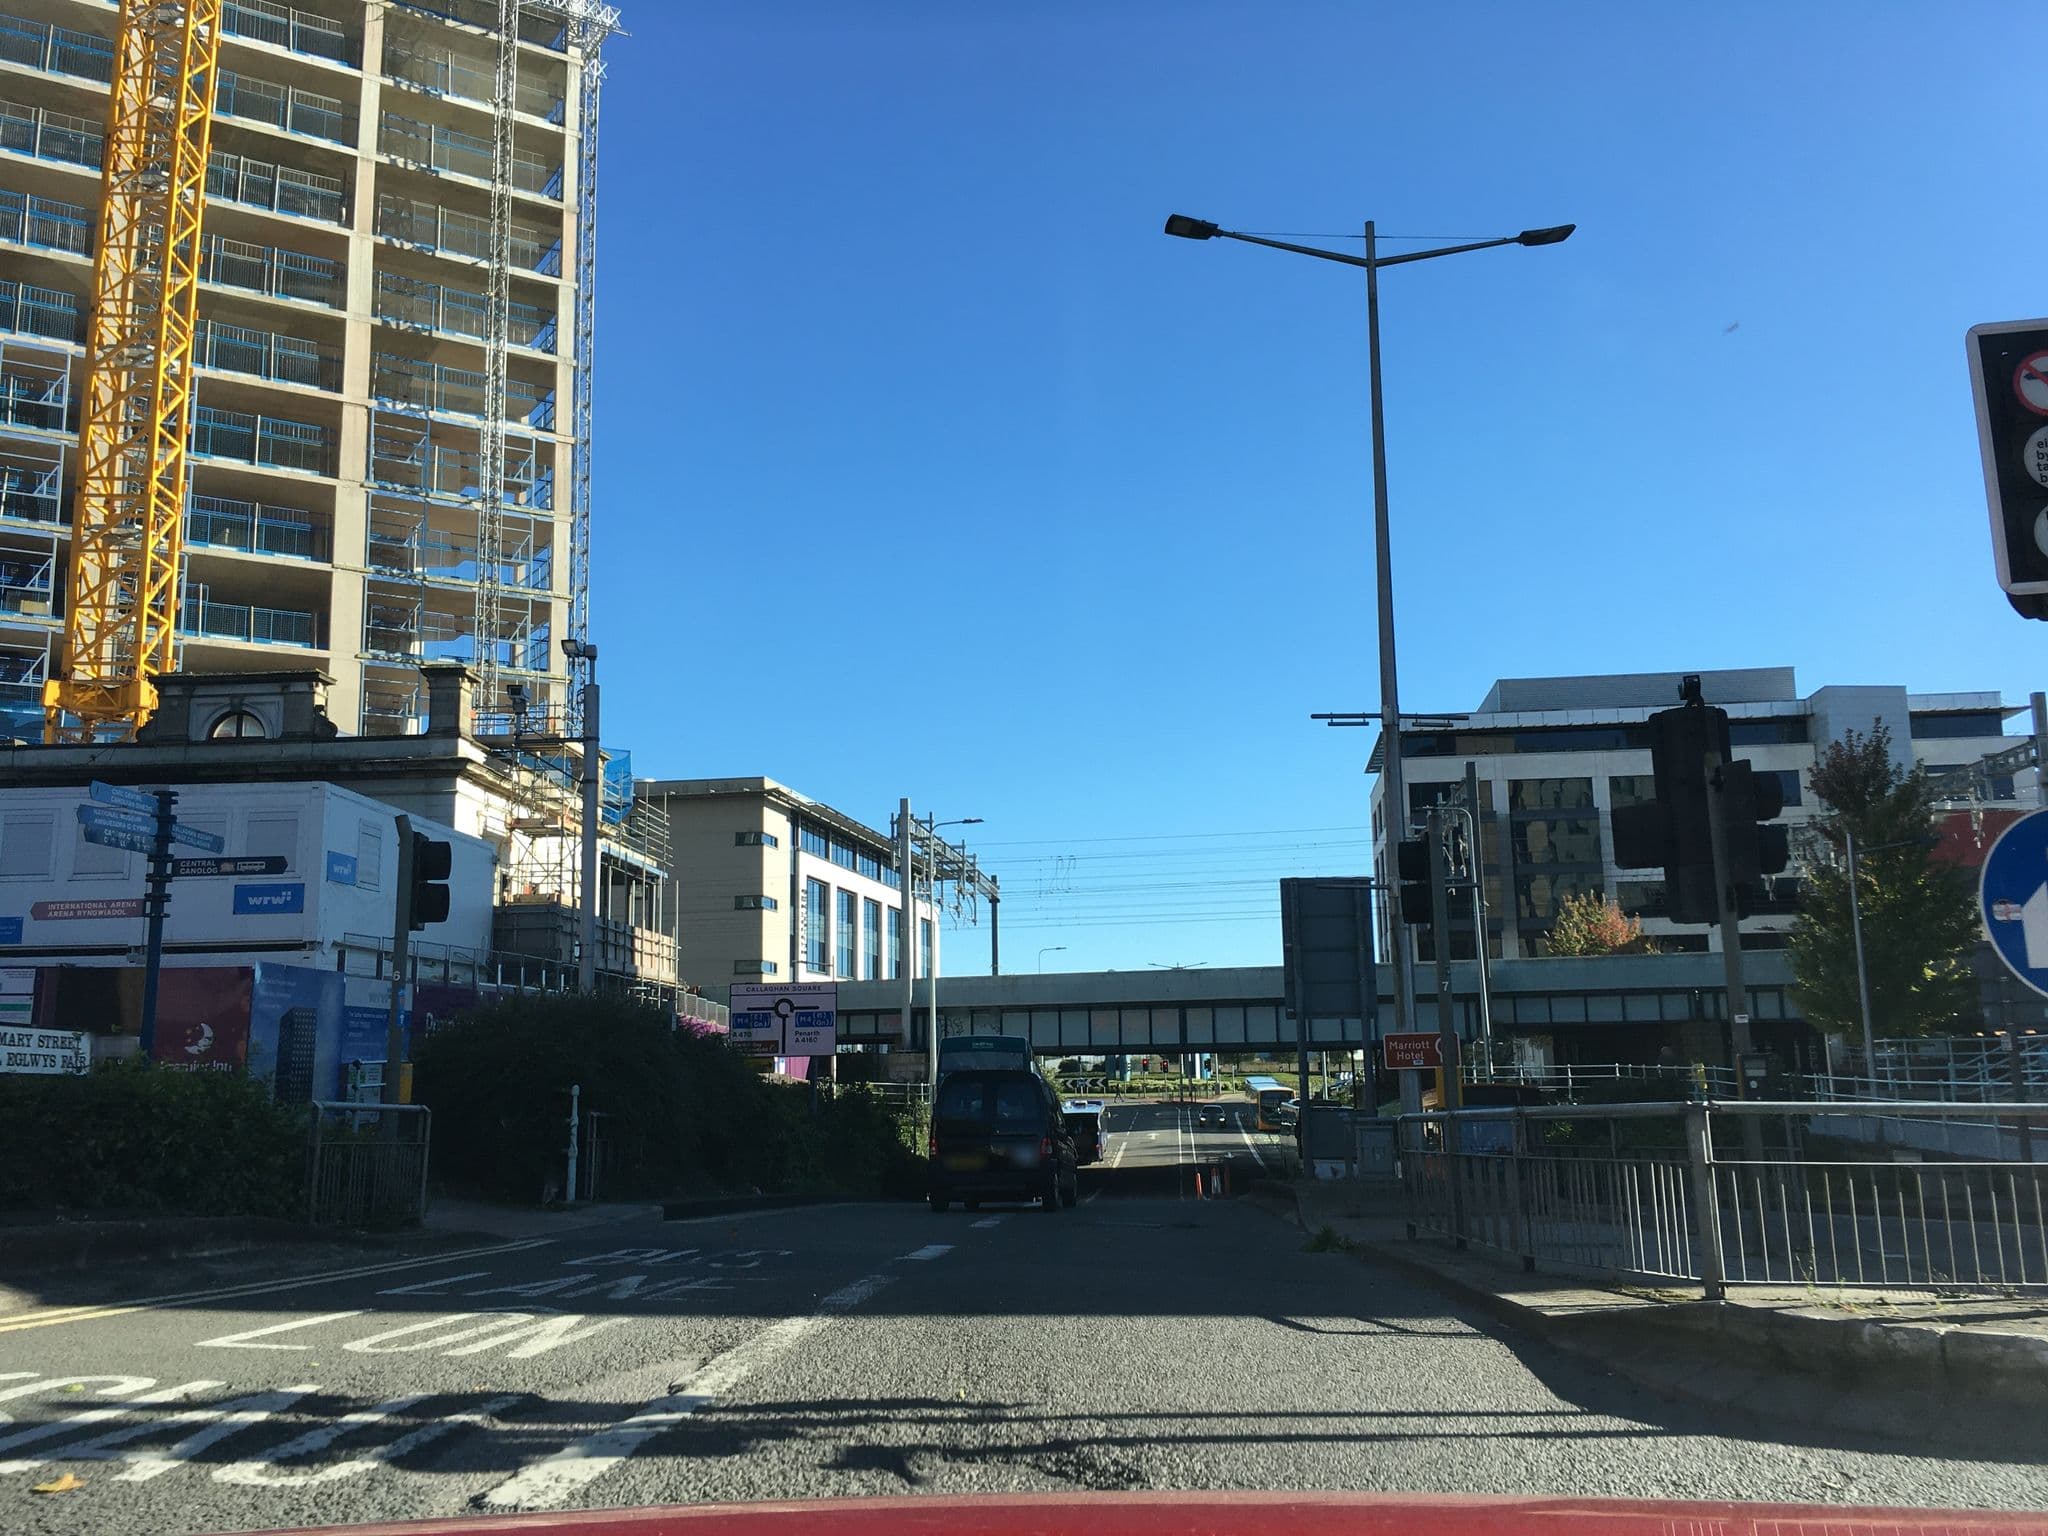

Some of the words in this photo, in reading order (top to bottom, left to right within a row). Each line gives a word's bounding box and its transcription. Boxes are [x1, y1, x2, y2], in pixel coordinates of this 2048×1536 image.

[248, 895, 287, 905] wrw
[48, 902, 107, 910] INTERNATIONAL
[393, 971, 400, 981] 6
[1441, 981, 1449, 991] 7
[0, 1032, 34, 1047] MARY
[37, 1034, 82, 1050] STREET
[1389, 1040, 1430, 1050] Marriott
[6, 1052, 57, 1068] EGLWYS
[1397, 1051, 1424, 1060] Hotel
